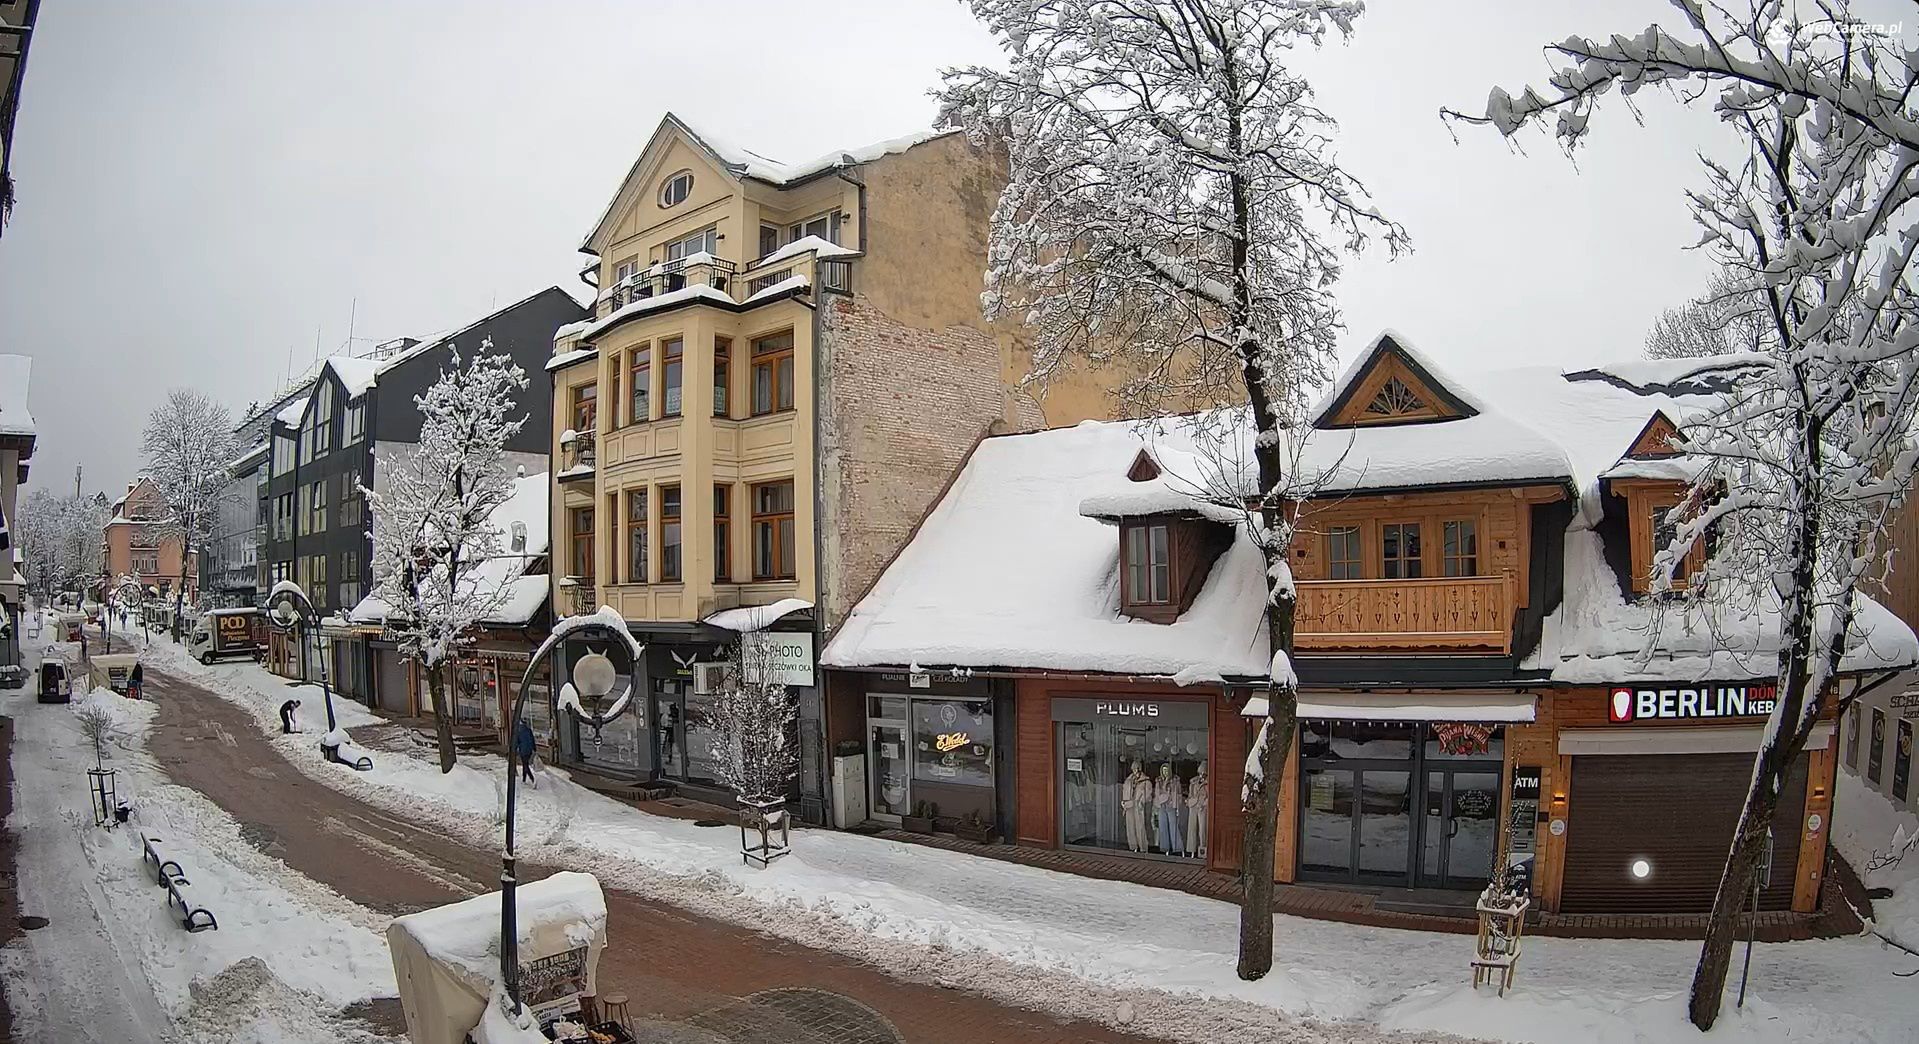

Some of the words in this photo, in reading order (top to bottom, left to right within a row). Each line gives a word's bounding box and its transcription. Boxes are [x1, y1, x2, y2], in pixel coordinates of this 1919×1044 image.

[220, 616, 246, 630] PCD
[1748, 684, 1776, 700] DÖN
[1096, 701, 1160, 717] PLUMS
[1636, 687, 1746, 719] BERLIN
[1748, 700, 1775, 715] KEB
[1515, 777, 1539, 789] ATM
